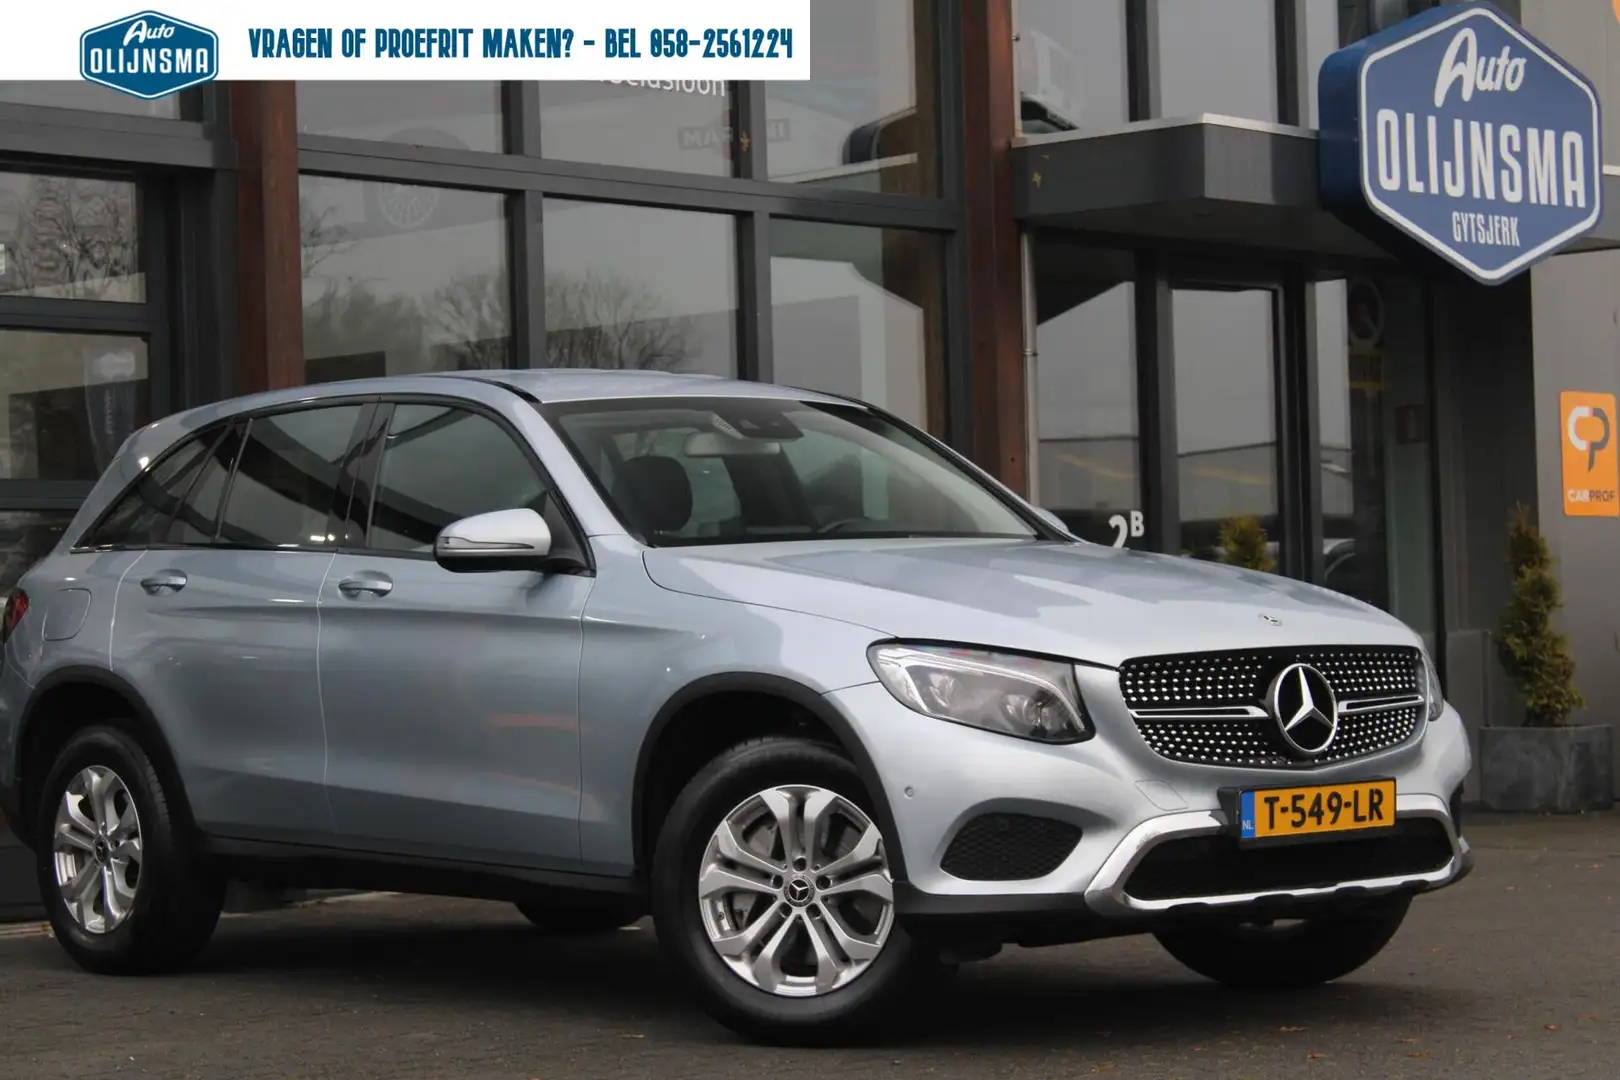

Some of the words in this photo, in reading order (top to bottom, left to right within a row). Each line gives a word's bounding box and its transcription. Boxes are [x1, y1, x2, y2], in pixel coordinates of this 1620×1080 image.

[1434, 27, 1527, 108] Auto
[1377, 108, 1586, 208] OLIJNSMA
[1451, 211, 1520, 247] GYTSJERK
[1242, 819, 1254, 831] NL
[1263, 788, 1384, 830] T-549-LR
